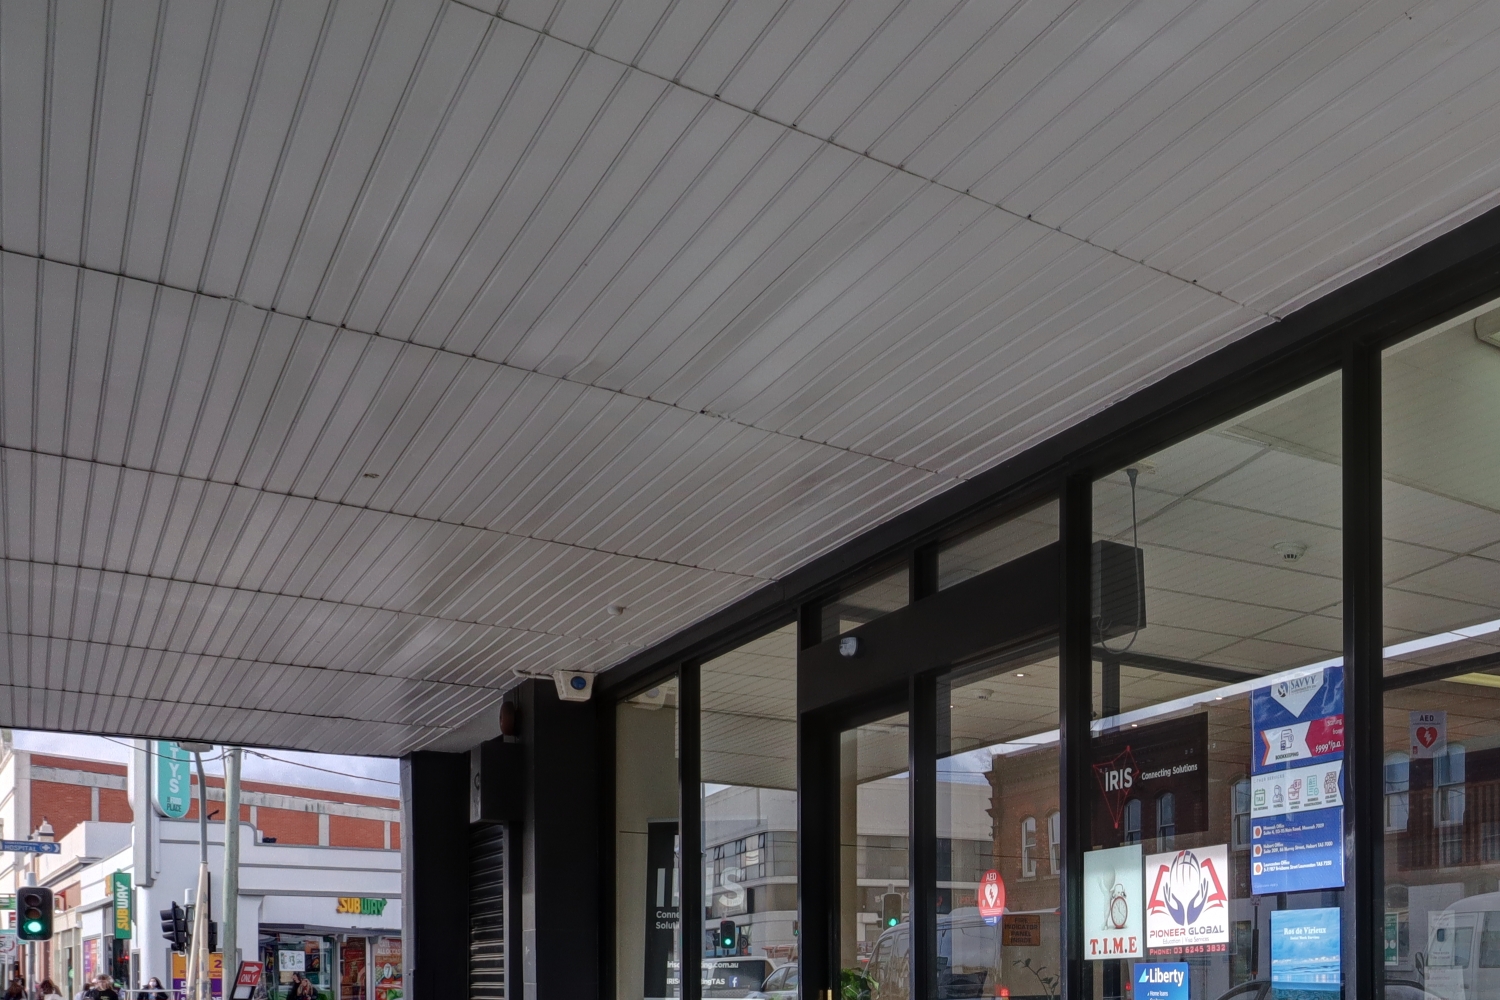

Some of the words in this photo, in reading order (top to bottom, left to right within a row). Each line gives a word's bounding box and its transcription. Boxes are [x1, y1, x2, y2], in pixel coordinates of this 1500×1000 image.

[1291, 675, 1316, 690] SAVVY
[1420, 714, 1434, 722] AED
[1105, 767, 1133, 792] IRIS
[1141, 767, 1171, 781] Connecting
[1172, 763, 1198, 775] Solutions
[166, 803, 182, 813] PLACE
[985, 872, 997, 881] AED
[116, 881, 130, 931] SUBWAY
[336, 897, 388, 917] SUBWAY
[1149, 928, 1186, 939] PIONEER
[1188, 925, 1224, 936] GLOBAL
[1090, 936, 1137, 955] T.I.M.E
[1206, 944, 1226, 952] 3832
[240, 974, 257, 983] ONLY
[1149, 967, 1184, 987] Liberty
